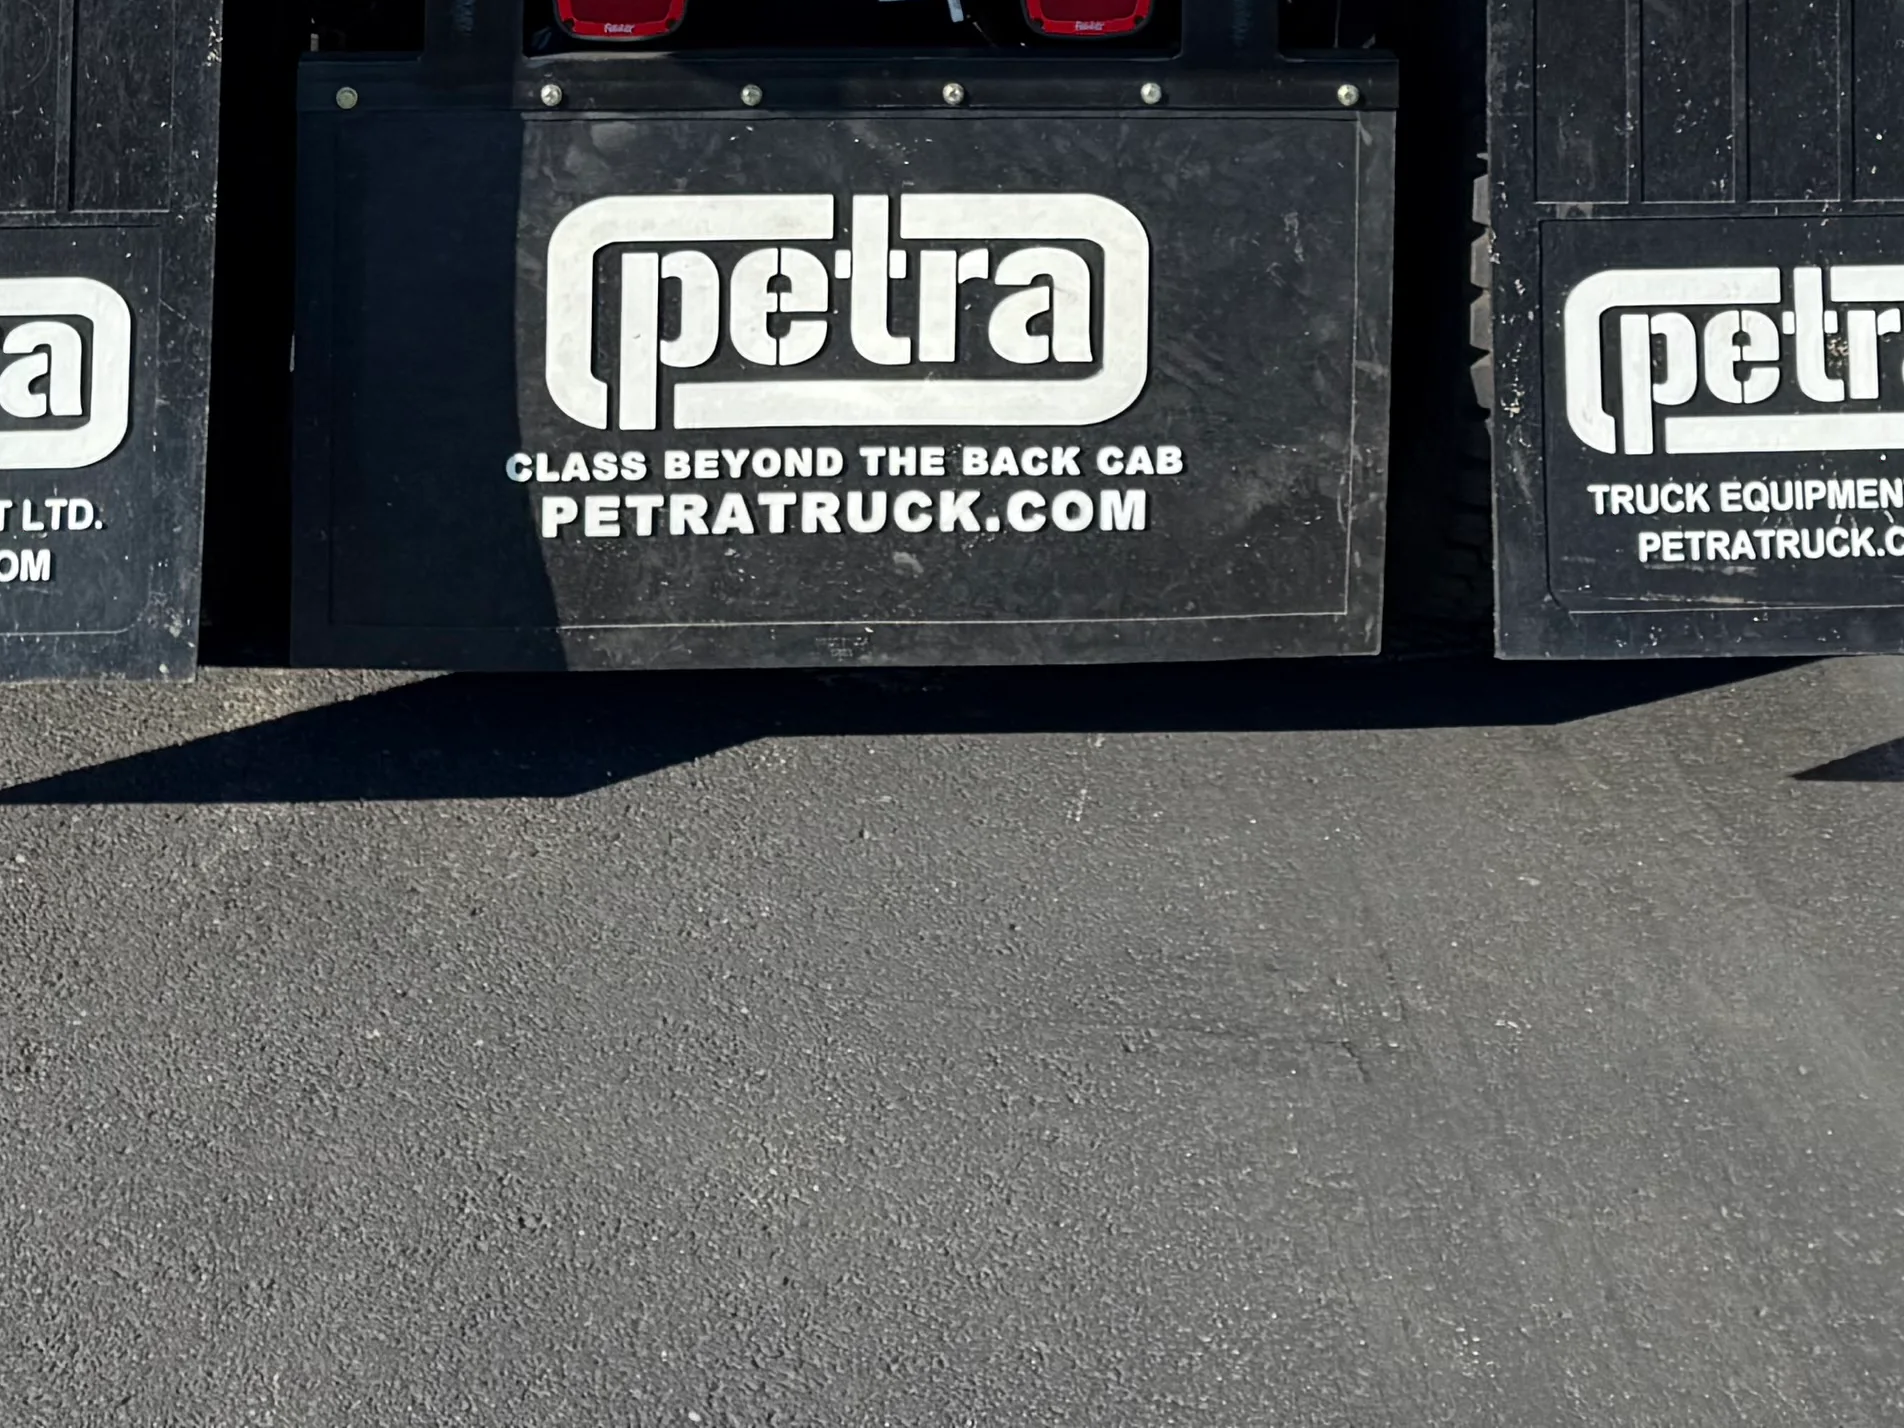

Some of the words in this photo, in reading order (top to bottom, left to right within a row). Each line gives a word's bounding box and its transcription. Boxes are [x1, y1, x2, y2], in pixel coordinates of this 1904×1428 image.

[618, 194, 1093, 431] petra
[506, 450, 647, 483] CLASS
[664, 447, 844, 480] BEYOND
[860, 446, 945, 477] THE
[962, 446, 1081, 477] BACK
[1096, 445, 1183, 476] CAB
[22, 497, 103, 532] LTD.
[541, 489, 1147, 538] PETRATRUCK.COM
[1586, 482, 1711, 515] TRUCK
